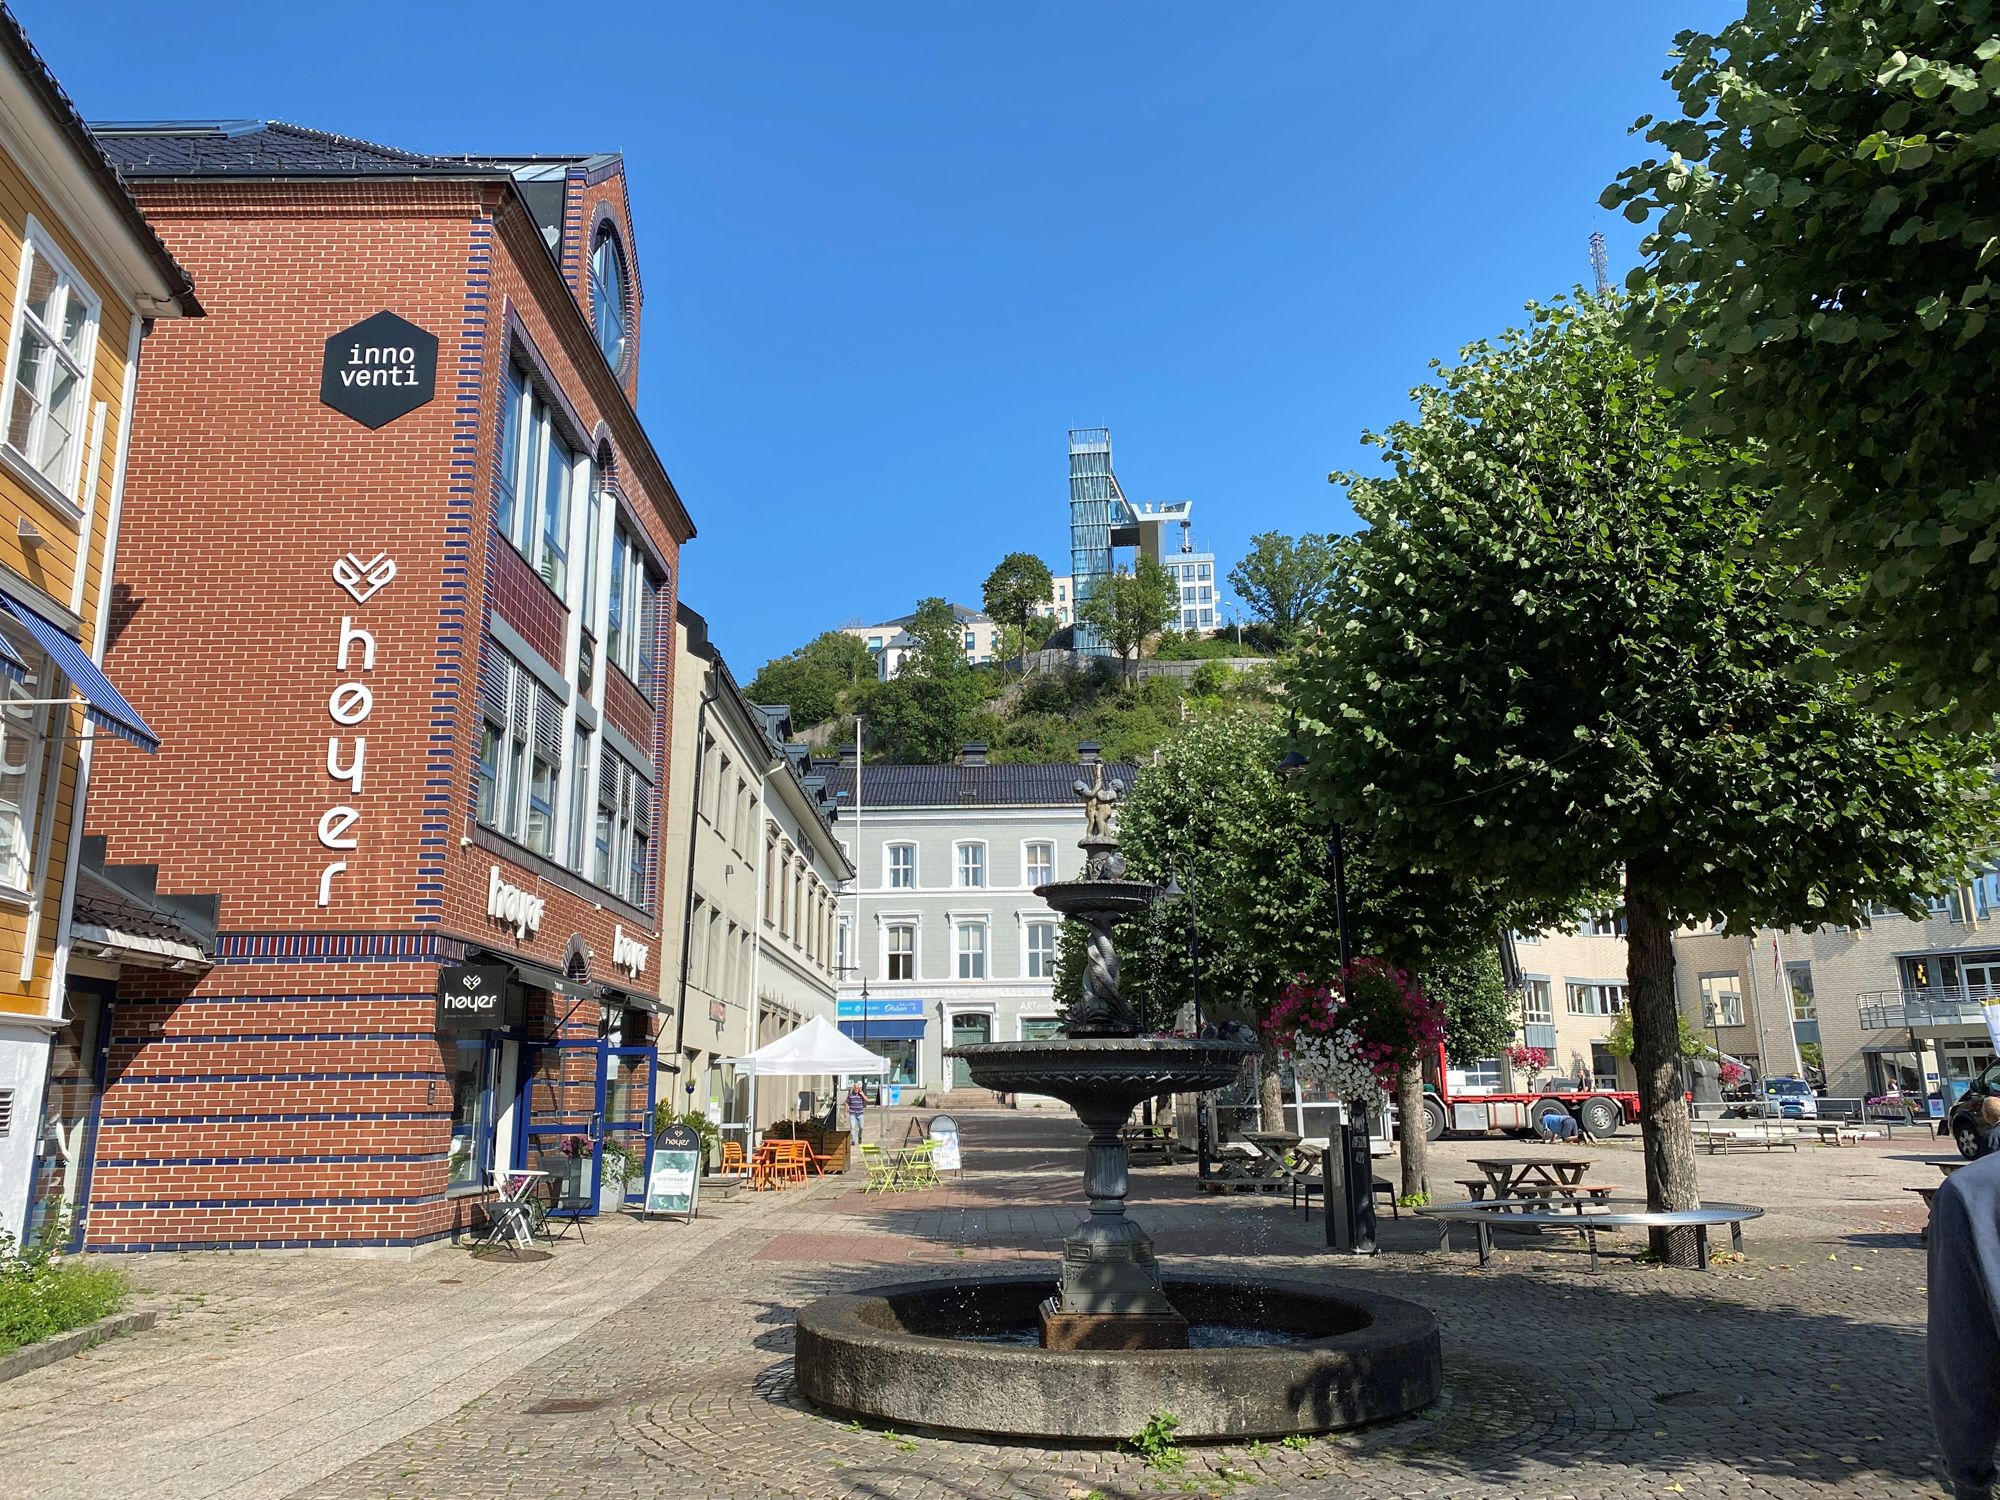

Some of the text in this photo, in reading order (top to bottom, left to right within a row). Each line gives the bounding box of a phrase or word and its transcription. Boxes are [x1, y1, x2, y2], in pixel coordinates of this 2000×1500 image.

[348, 343, 415, 364] inno
[340, 364, 419, 387] venti
[317, 616, 375, 906] høyer
[444, 992, 498, 1012] høyer
